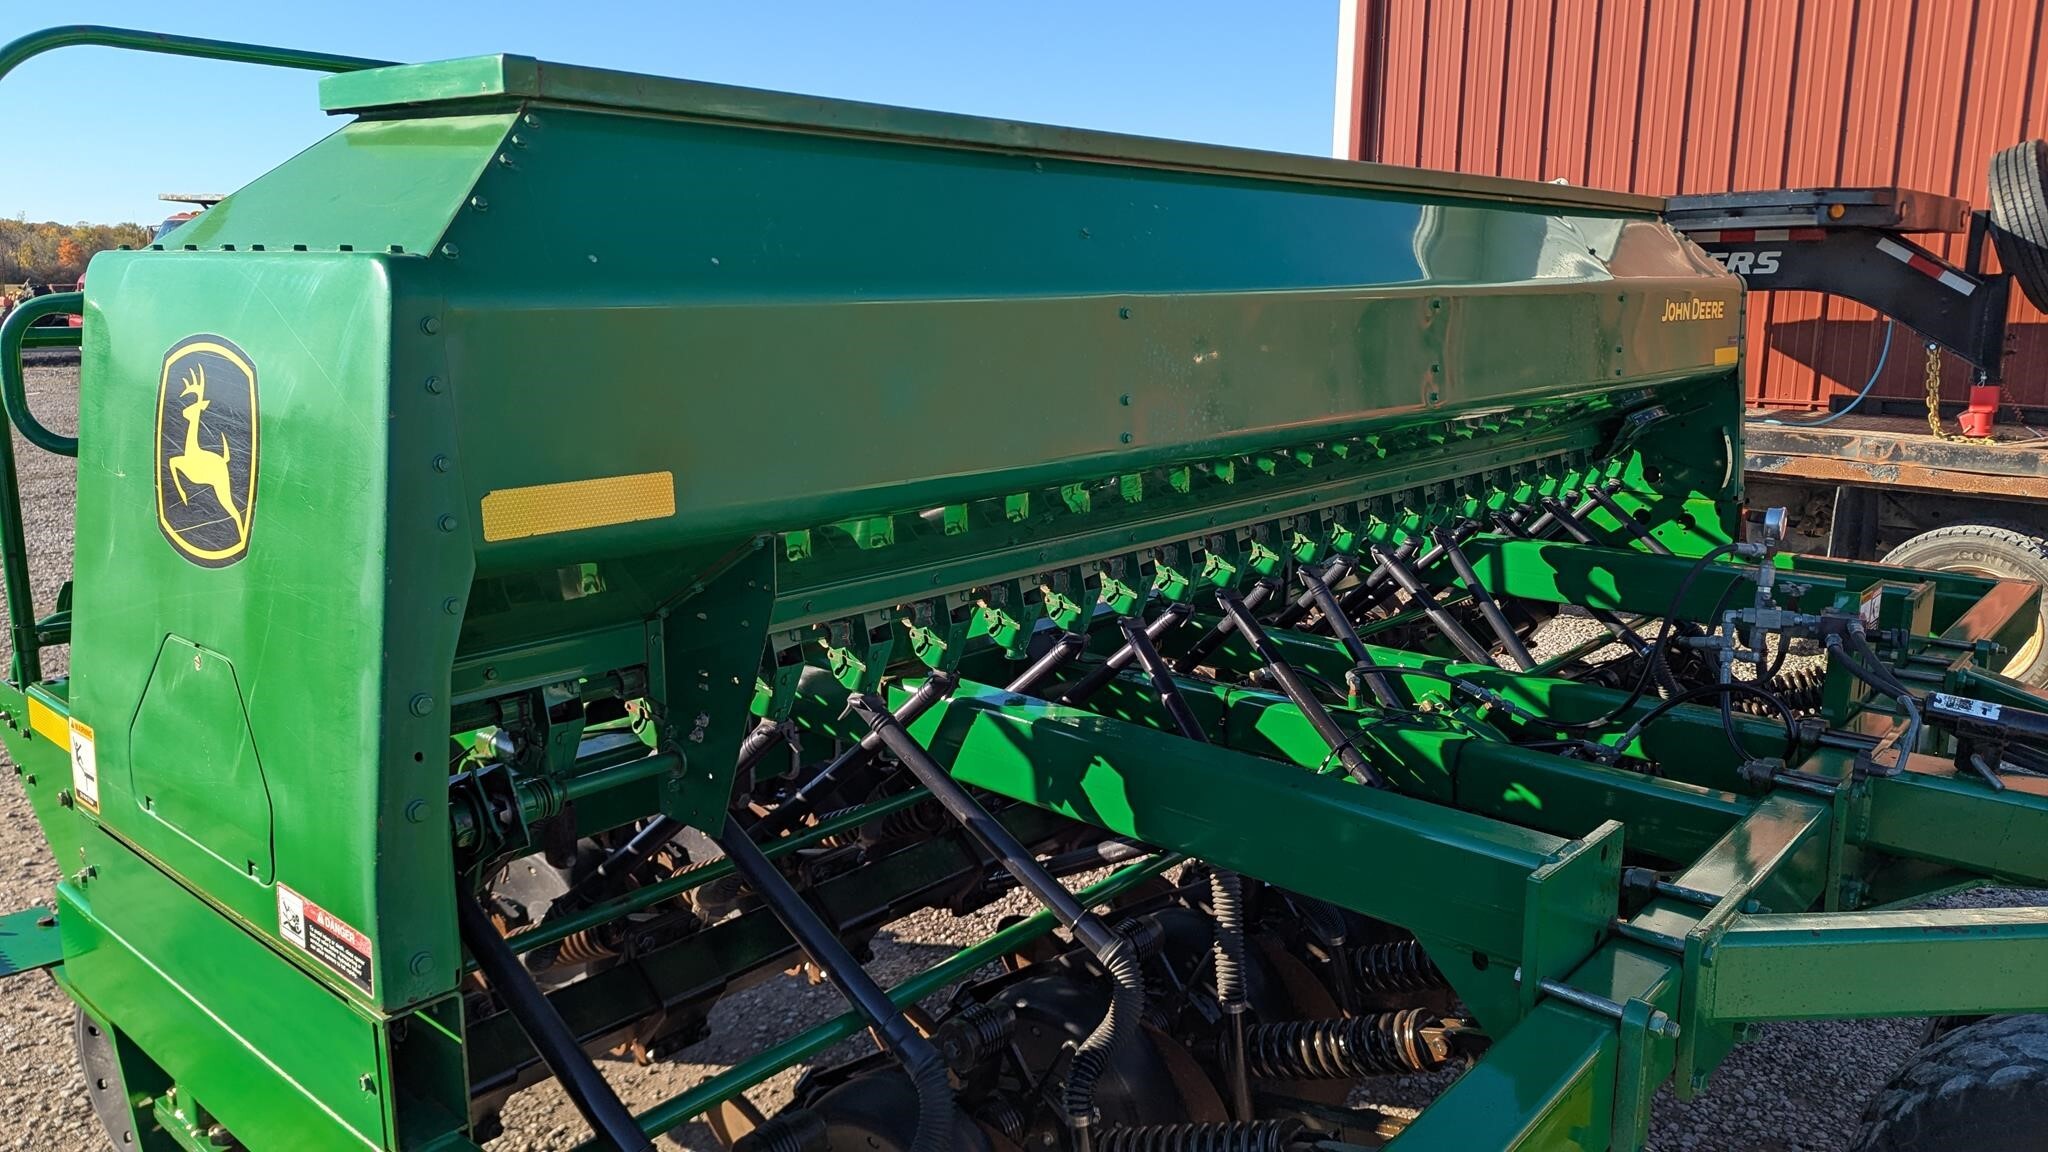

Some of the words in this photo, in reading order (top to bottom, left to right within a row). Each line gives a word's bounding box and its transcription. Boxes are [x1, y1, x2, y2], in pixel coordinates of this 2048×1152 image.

[1662, 298, 1690, 321] JOHN
[1692, 298, 1724, 320] DEERE
[325, 915, 356, 945] DANGER
